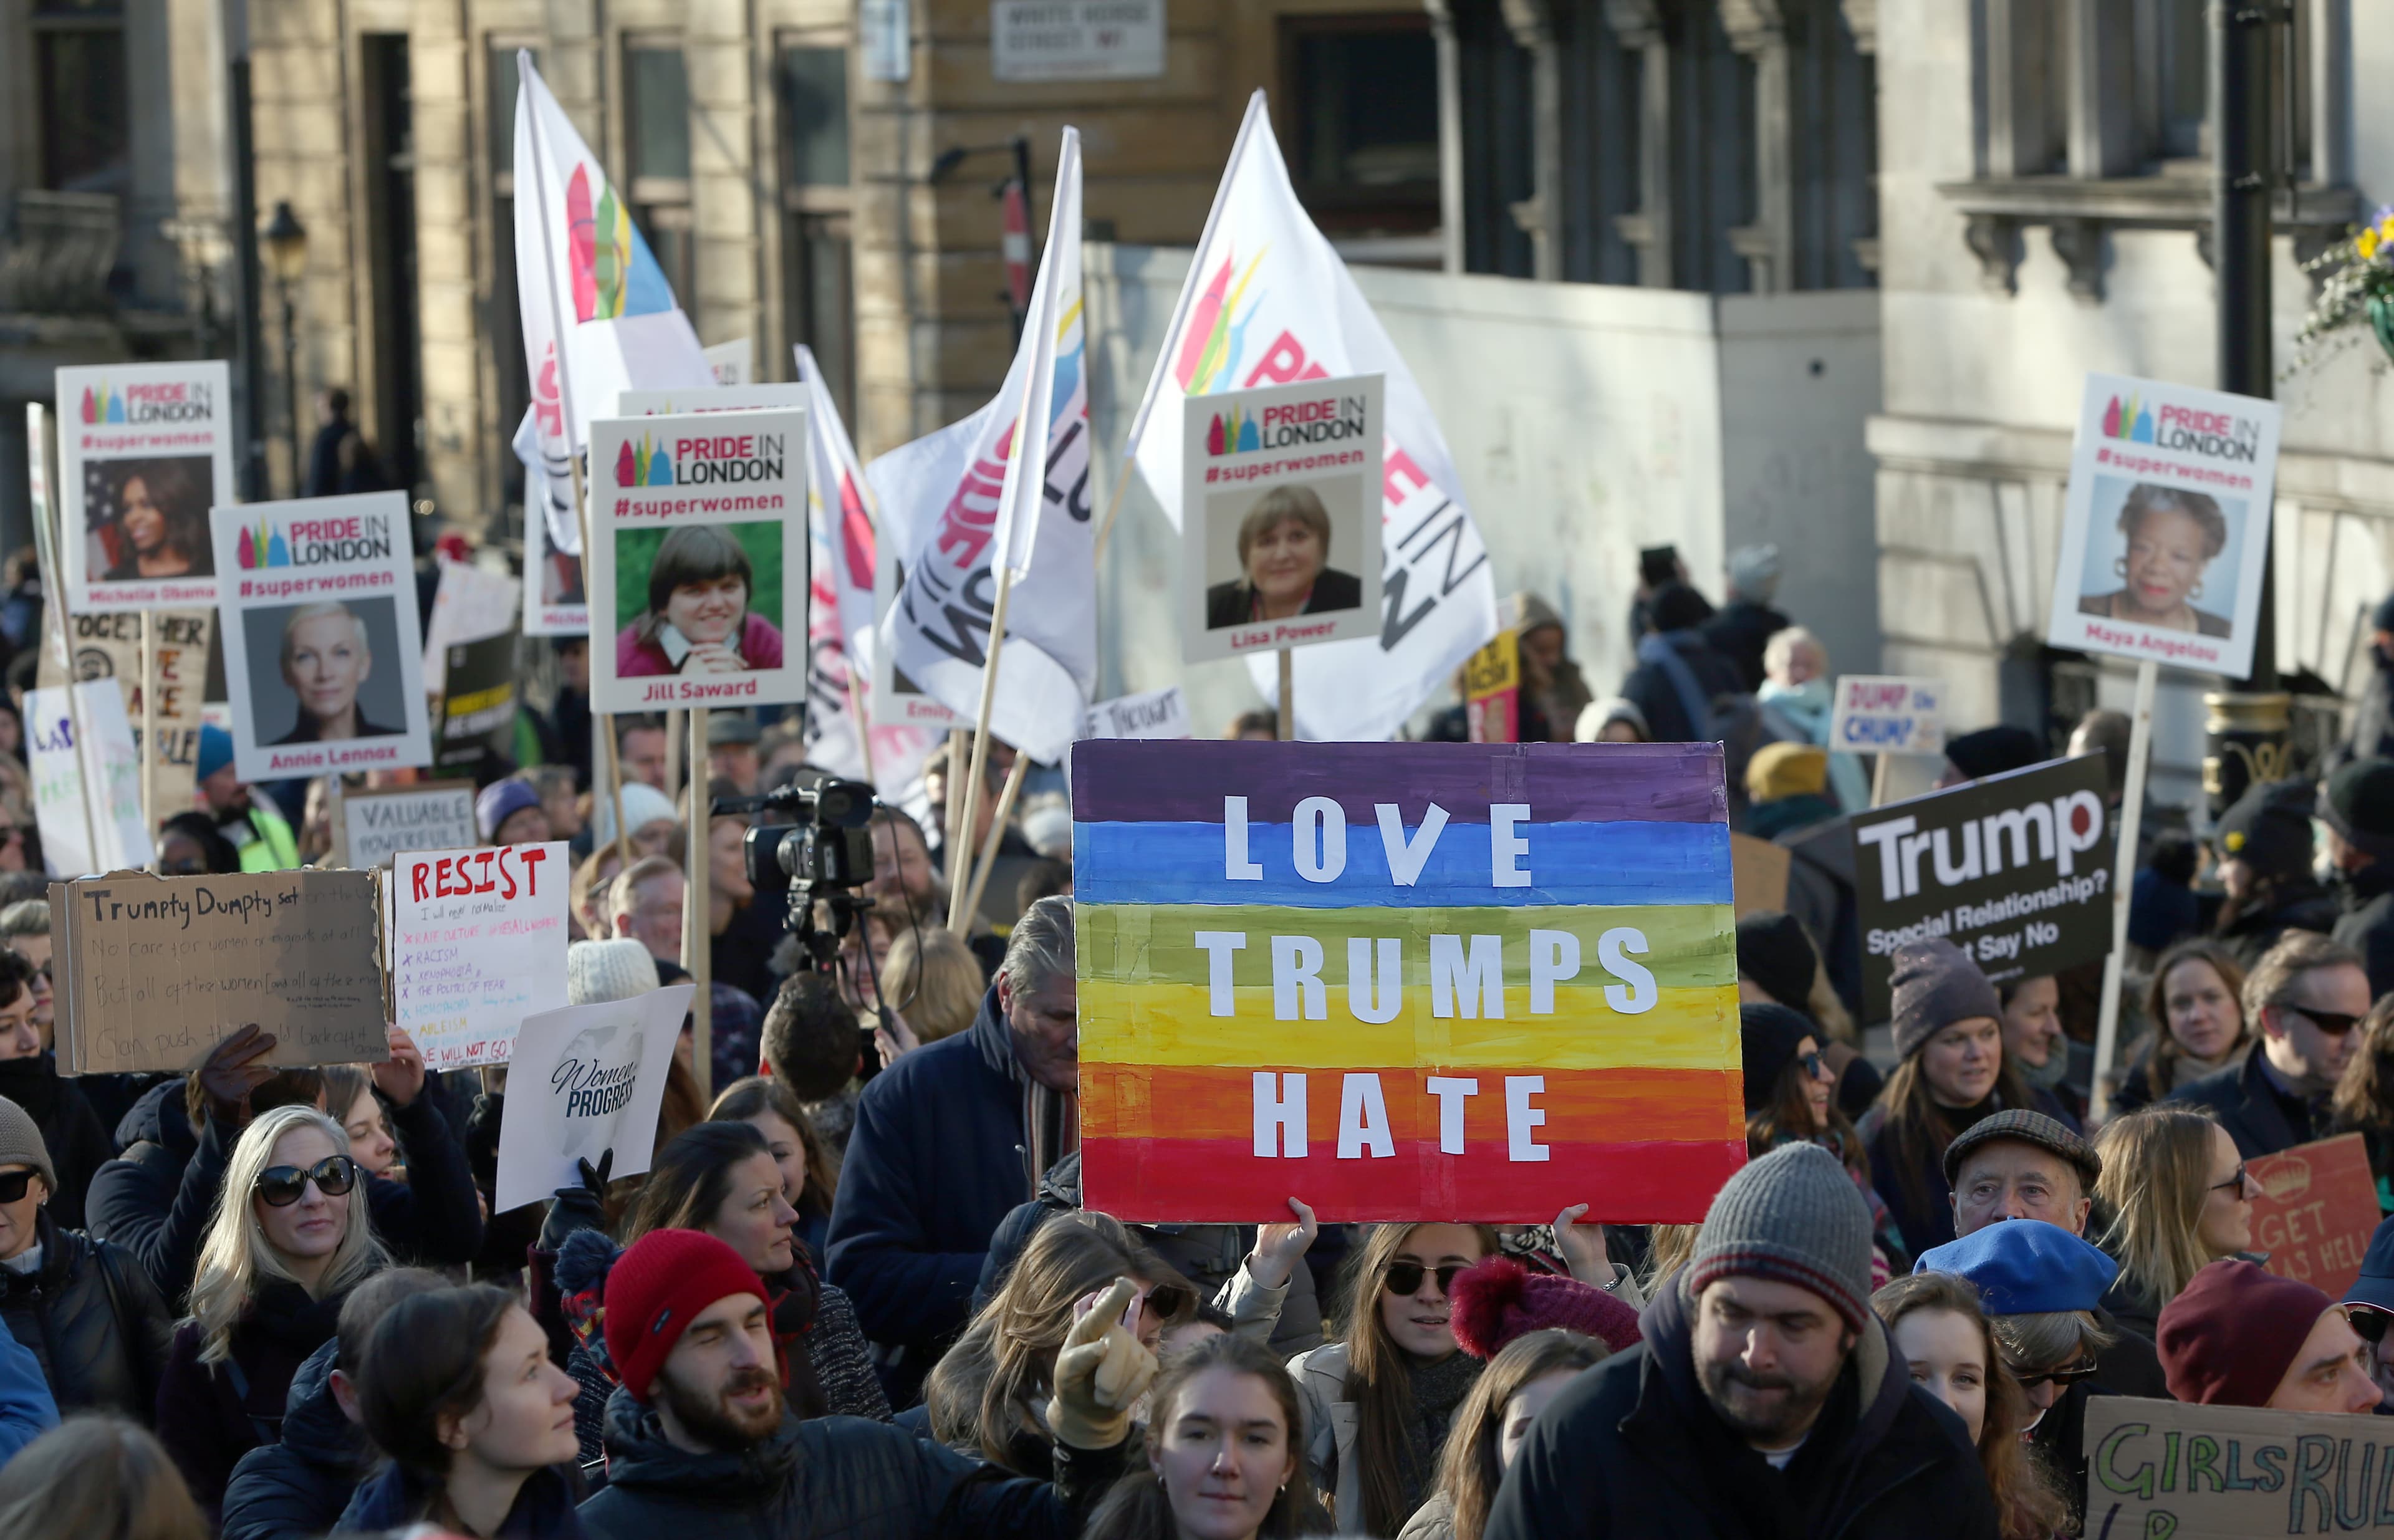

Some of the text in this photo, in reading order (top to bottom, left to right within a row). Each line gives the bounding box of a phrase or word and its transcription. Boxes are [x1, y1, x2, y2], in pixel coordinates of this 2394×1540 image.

[127, 382, 212, 403] PRIDE IN
[127, 401, 213, 424] LONDON
[1263, 395, 1365, 426] PRIDE IN
[2159, 404, 2261, 440] PRIDE IN
[81, 431, 214, 451] #superwomen
[676, 434, 785, 460] PRIDE IN
[1263, 418, 1364, 450] LONDON
[2157, 427, 2256, 463] LONDON
[676, 458, 783, 485] LONDON
[1205, 449, 1365, 484] #superwomen
[2096, 448, 2252, 489] #superwomen
[614, 494, 784, 518] #superwomen
[290, 514, 389, 542] PRIDE IN
[292, 536, 390, 567] LONDON
[239, 570, 394, 597] #superwomen
[1231, 620, 1336, 649] Lisa Power
[2085, 623, 2218, 662] Maya Angelou
[643, 679, 757, 701] Jill Saward
[1849, 682, 1908, 710] DUMP
[907, 701, 954, 721] Emily
[1844, 715, 1914, 745] CHUMP
[269, 746, 397, 770] Annie Lennox
[360, 796, 468, 828] VALUABLE
[1225, 796, 1531, 888] LOVE
[1857, 789, 2104, 902] Trump
[412, 846, 546, 903] RESIST
[84, 889, 190, 930] Trumpty
[196, 887, 271, 924] Dumpty
[279, 886, 298, 905] sat
[1867, 910, 1951, 955] Special
[1955, 869, 2108, 931] Relationship?
[92, 938, 118, 957] No
[128, 941, 163, 958] care
[171, 941, 200, 958] for
[209, 935, 248, 952] women
[416, 946, 458, 965] RACISM
[1978, 932, 2022, 961] Say
[2025, 922, 2059, 948] No
[95, 975, 125, 1008] But
[137, 976, 155, 1002] all
[221, 975, 262, 991] women
[291, 971, 305, 989] all
[418, 984, 432, 996] THE
[468, 981, 479, 993] OF
[484, 979, 505, 993] FEAR
[1195, 927, 1658, 1024] TRUMPS
[419, 1017, 466, 1037] ABLEISM
[155, 1025, 198, 1062] push
[441, 1047, 462, 1061] WILL
[467, 1041, 486, 1057] NOT
[491, 1039, 506, 1059] GO
[1253, 1072, 1550, 1162] HATE
[2259, 1200, 2325, 1249] GET
[2096, 1423, 2287, 1500] GIRLS
